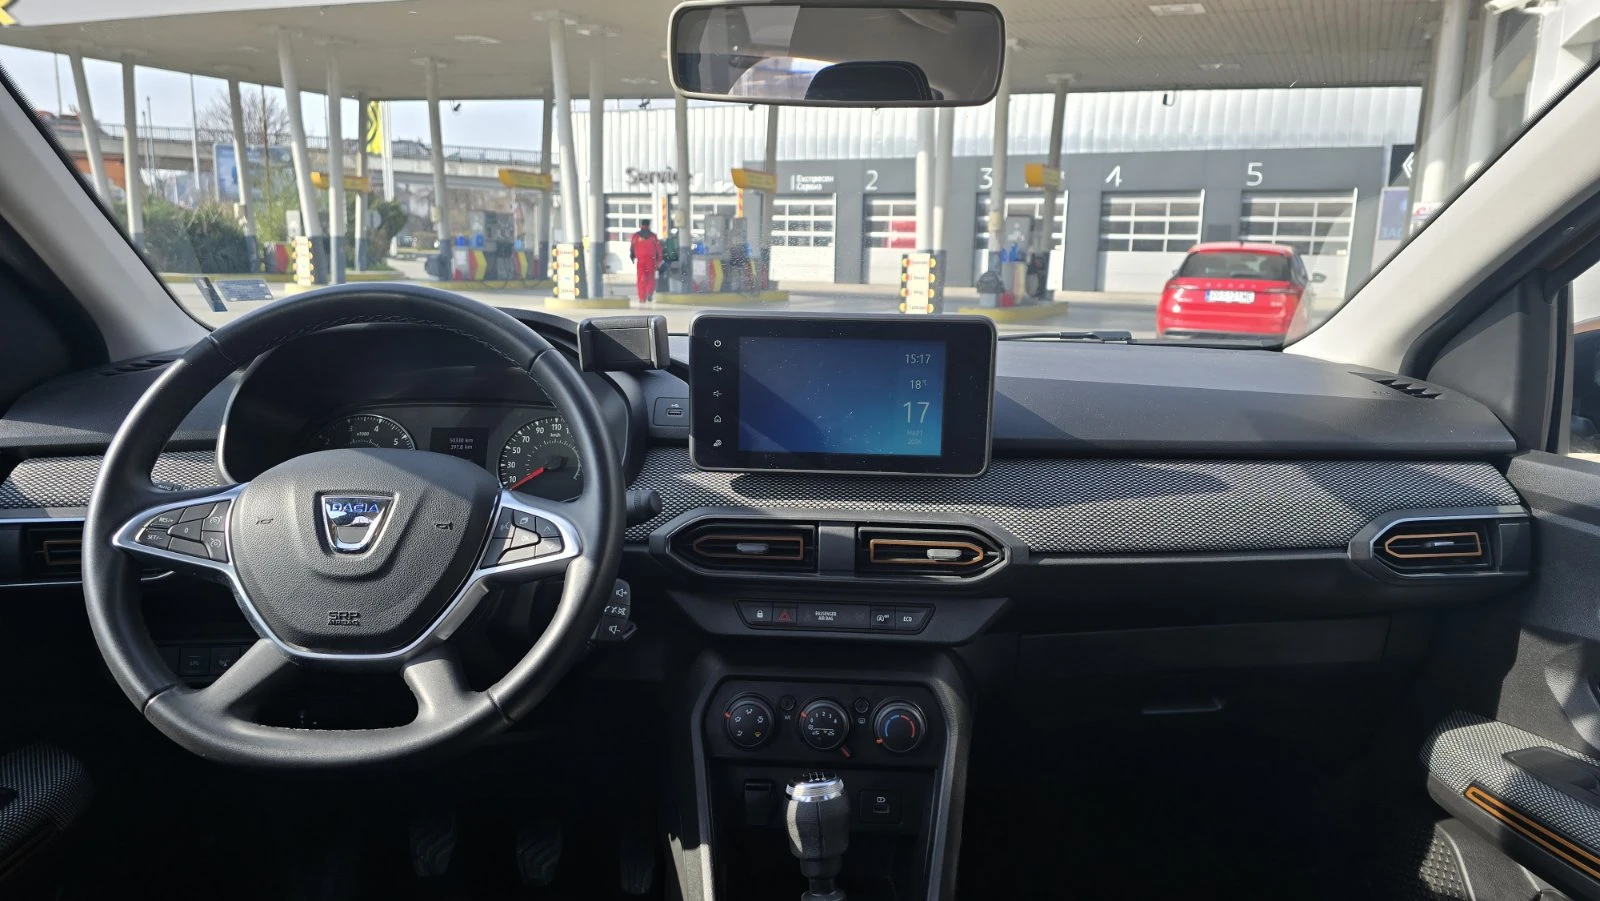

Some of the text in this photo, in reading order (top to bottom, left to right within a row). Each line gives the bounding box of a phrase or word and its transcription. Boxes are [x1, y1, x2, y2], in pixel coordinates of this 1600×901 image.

[625, 166, 694, 185] Servic
[980, 168, 993, 189] 3
[1105, 165, 1123, 187] 4
[1246, 162, 1263, 186] 5
[865, 170, 878, 190] 2
[905, 354, 931, 364] 15:17
[903, 401, 930, 423] 17
[551, 423, 562, 431] 110
[393, 438, 399, 446] 5
[521, 435, 531, 443] 70
[512, 446, 521, 454] 50
[506, 461, 516, 469] 30
[508, 475, 517, 483] 10
[330, 502, 380, 513] DACIA
